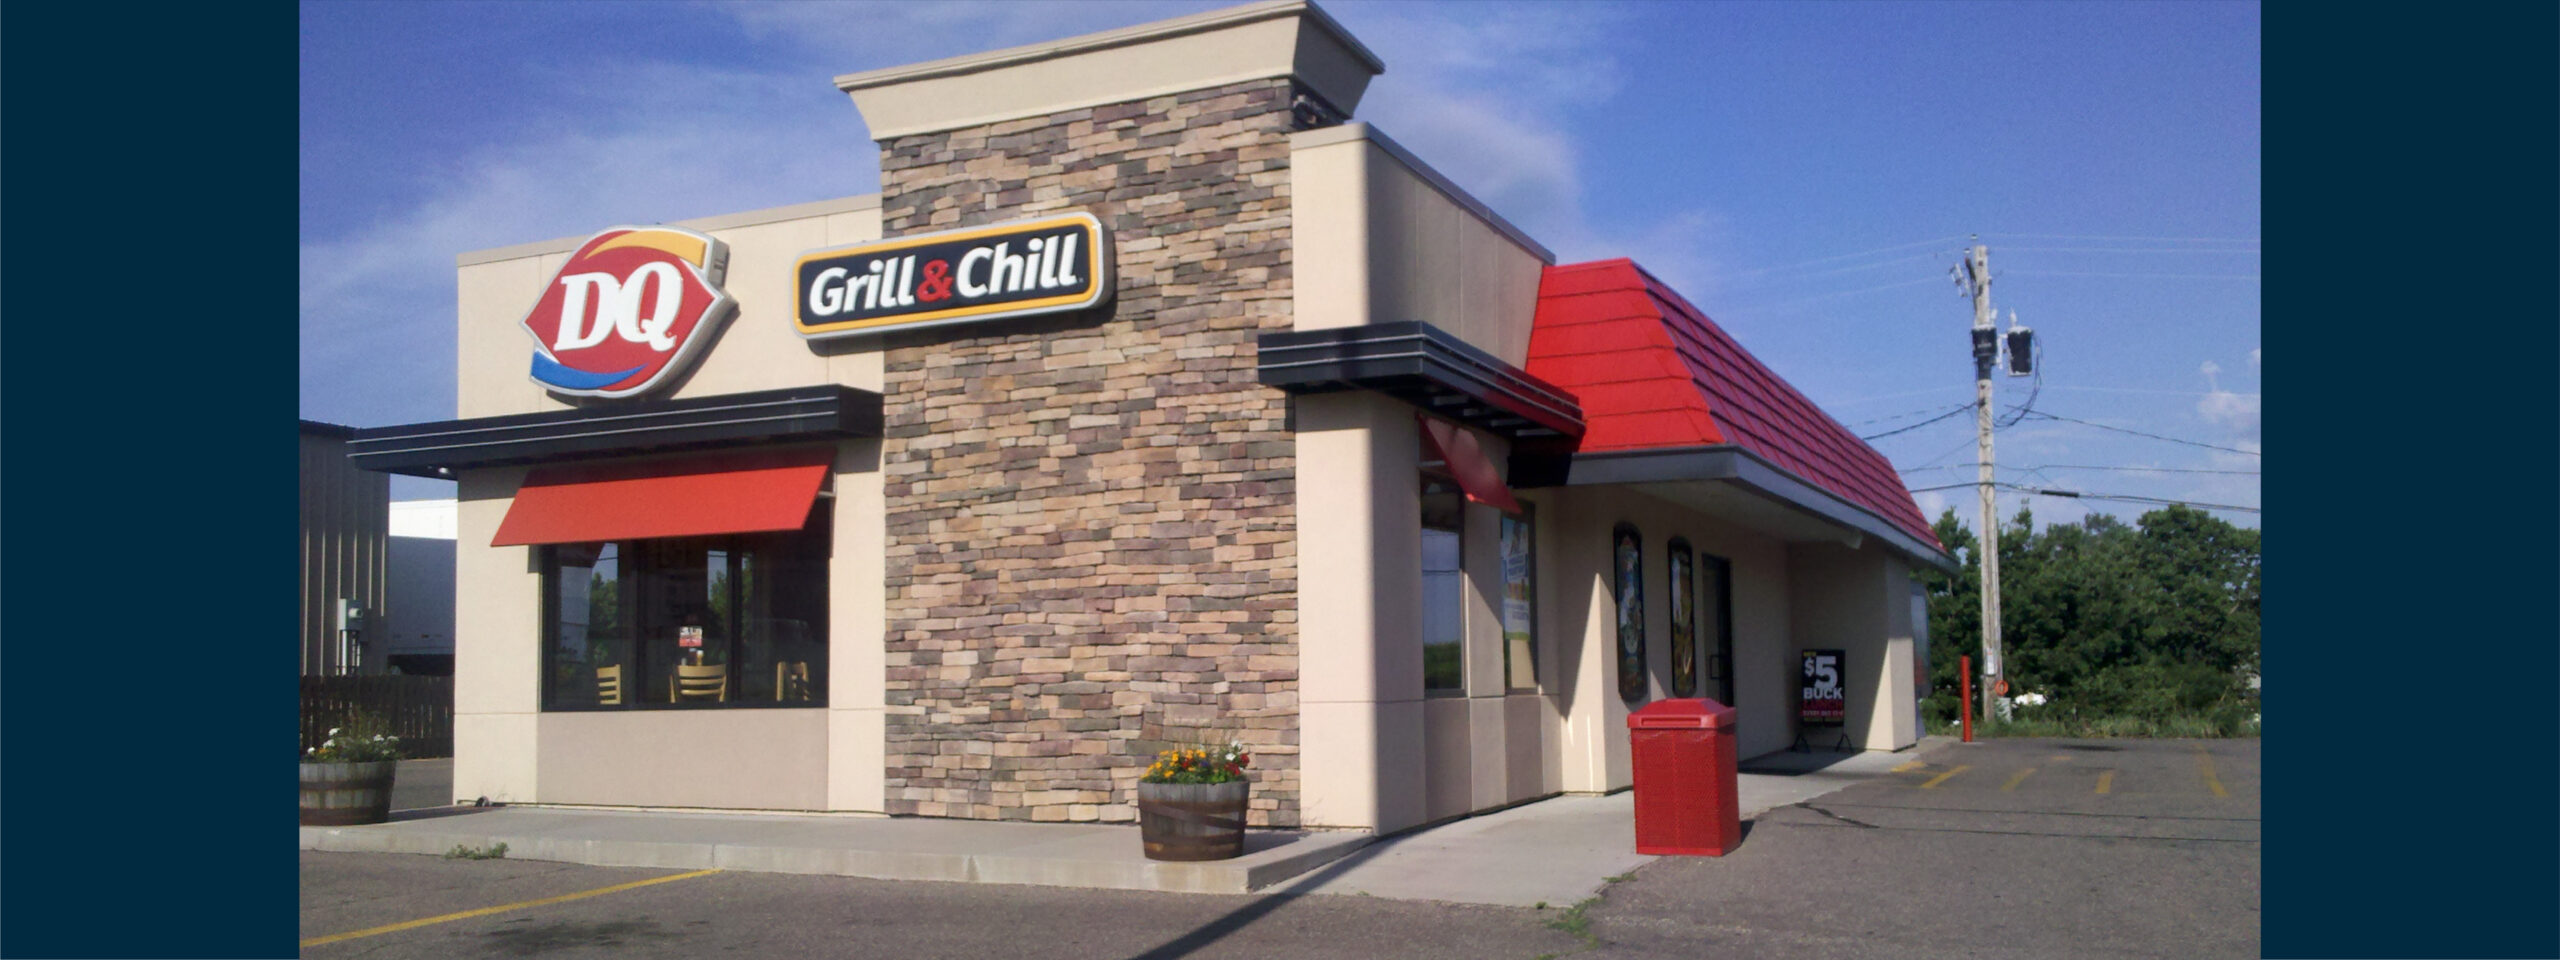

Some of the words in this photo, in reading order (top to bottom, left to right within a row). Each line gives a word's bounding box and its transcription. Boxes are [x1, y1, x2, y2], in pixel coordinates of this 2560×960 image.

[553, 261, 684, 352] DQ
[1804, 655, 1838, 688] $5
[1803, 687, 1843, 700] BUCK
